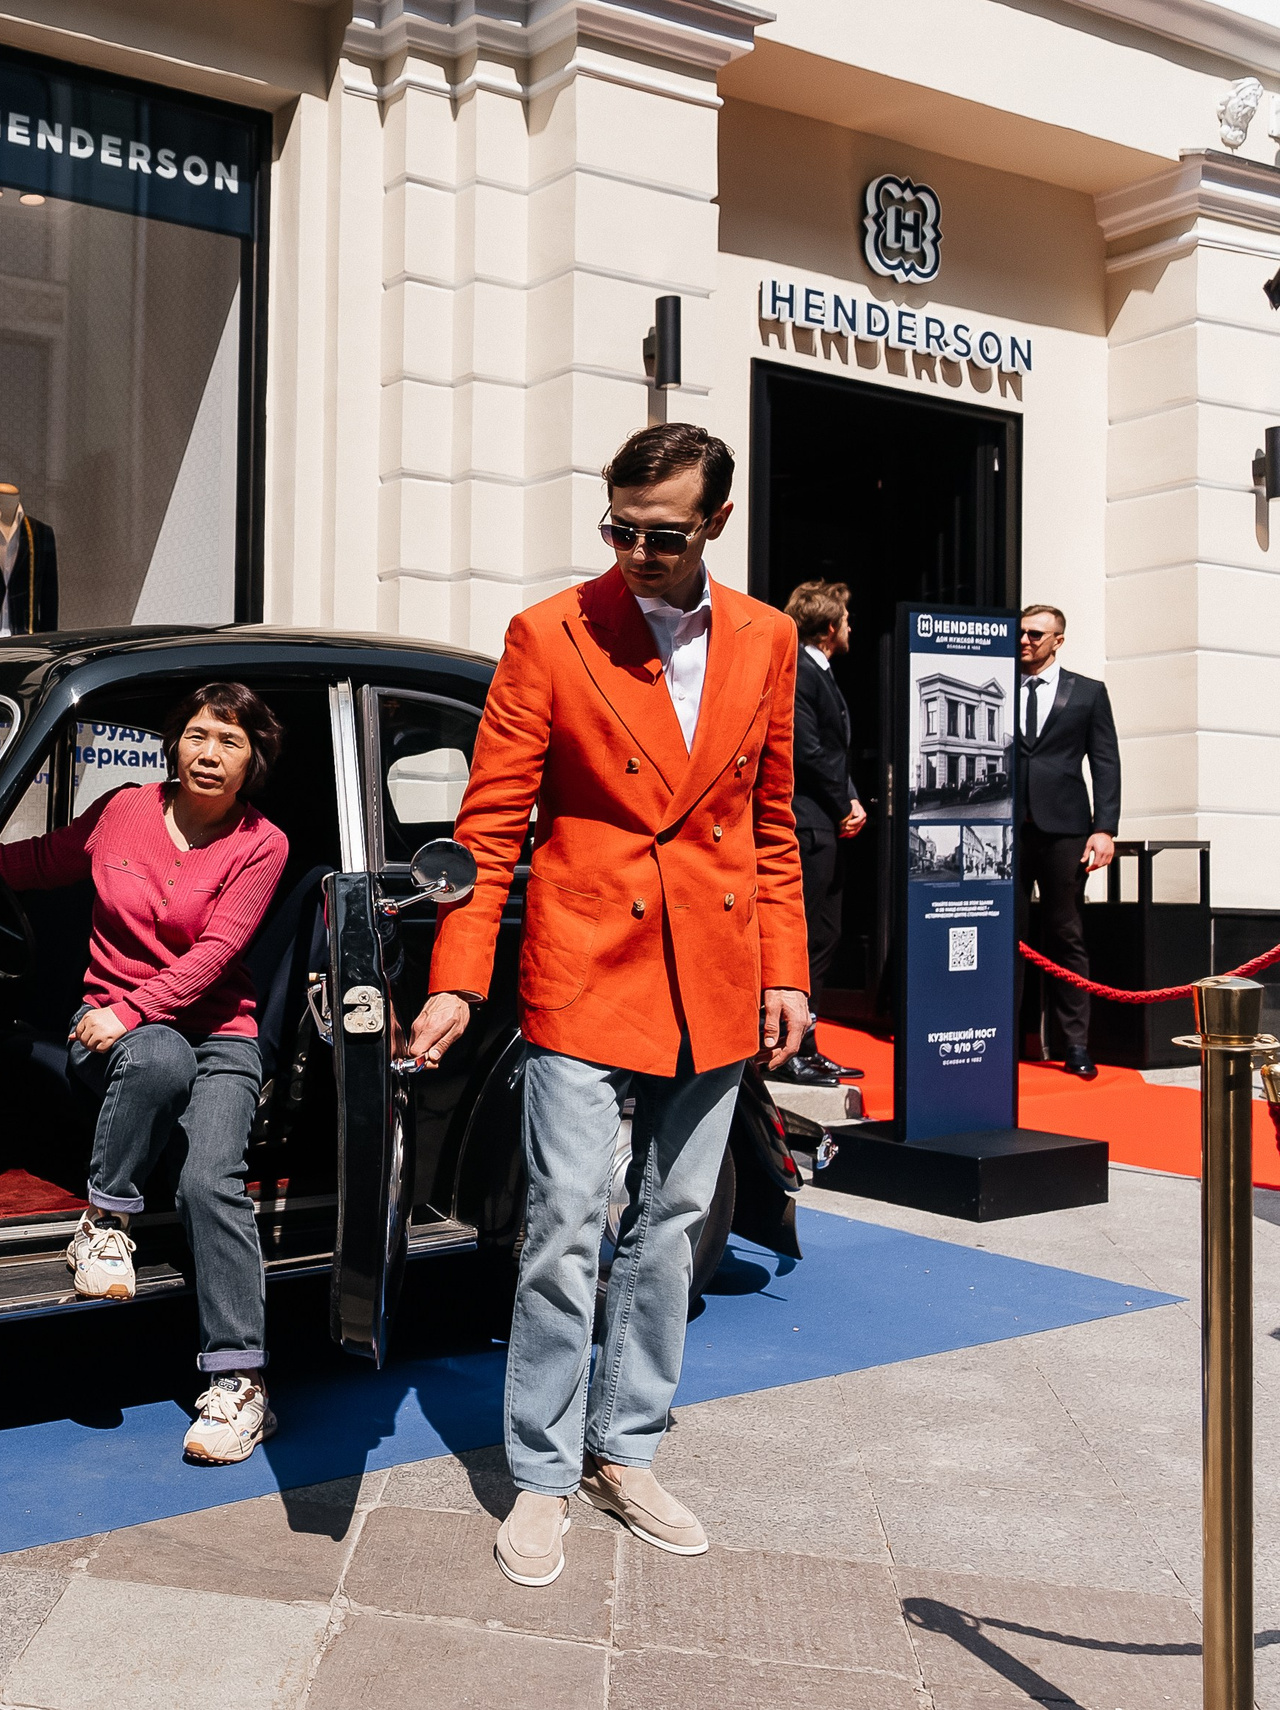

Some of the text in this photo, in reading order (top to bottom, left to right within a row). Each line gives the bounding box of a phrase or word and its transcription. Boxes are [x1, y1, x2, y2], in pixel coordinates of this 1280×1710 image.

[762, 279, 1033, 374] HENDERSON
[934, 619, 1008, 636] HENDERSON
[928, 1027, 997, 1043] КУЗНЕЦКИЙ МОСТ
[954, 1042, 971, 1054] 9/10
